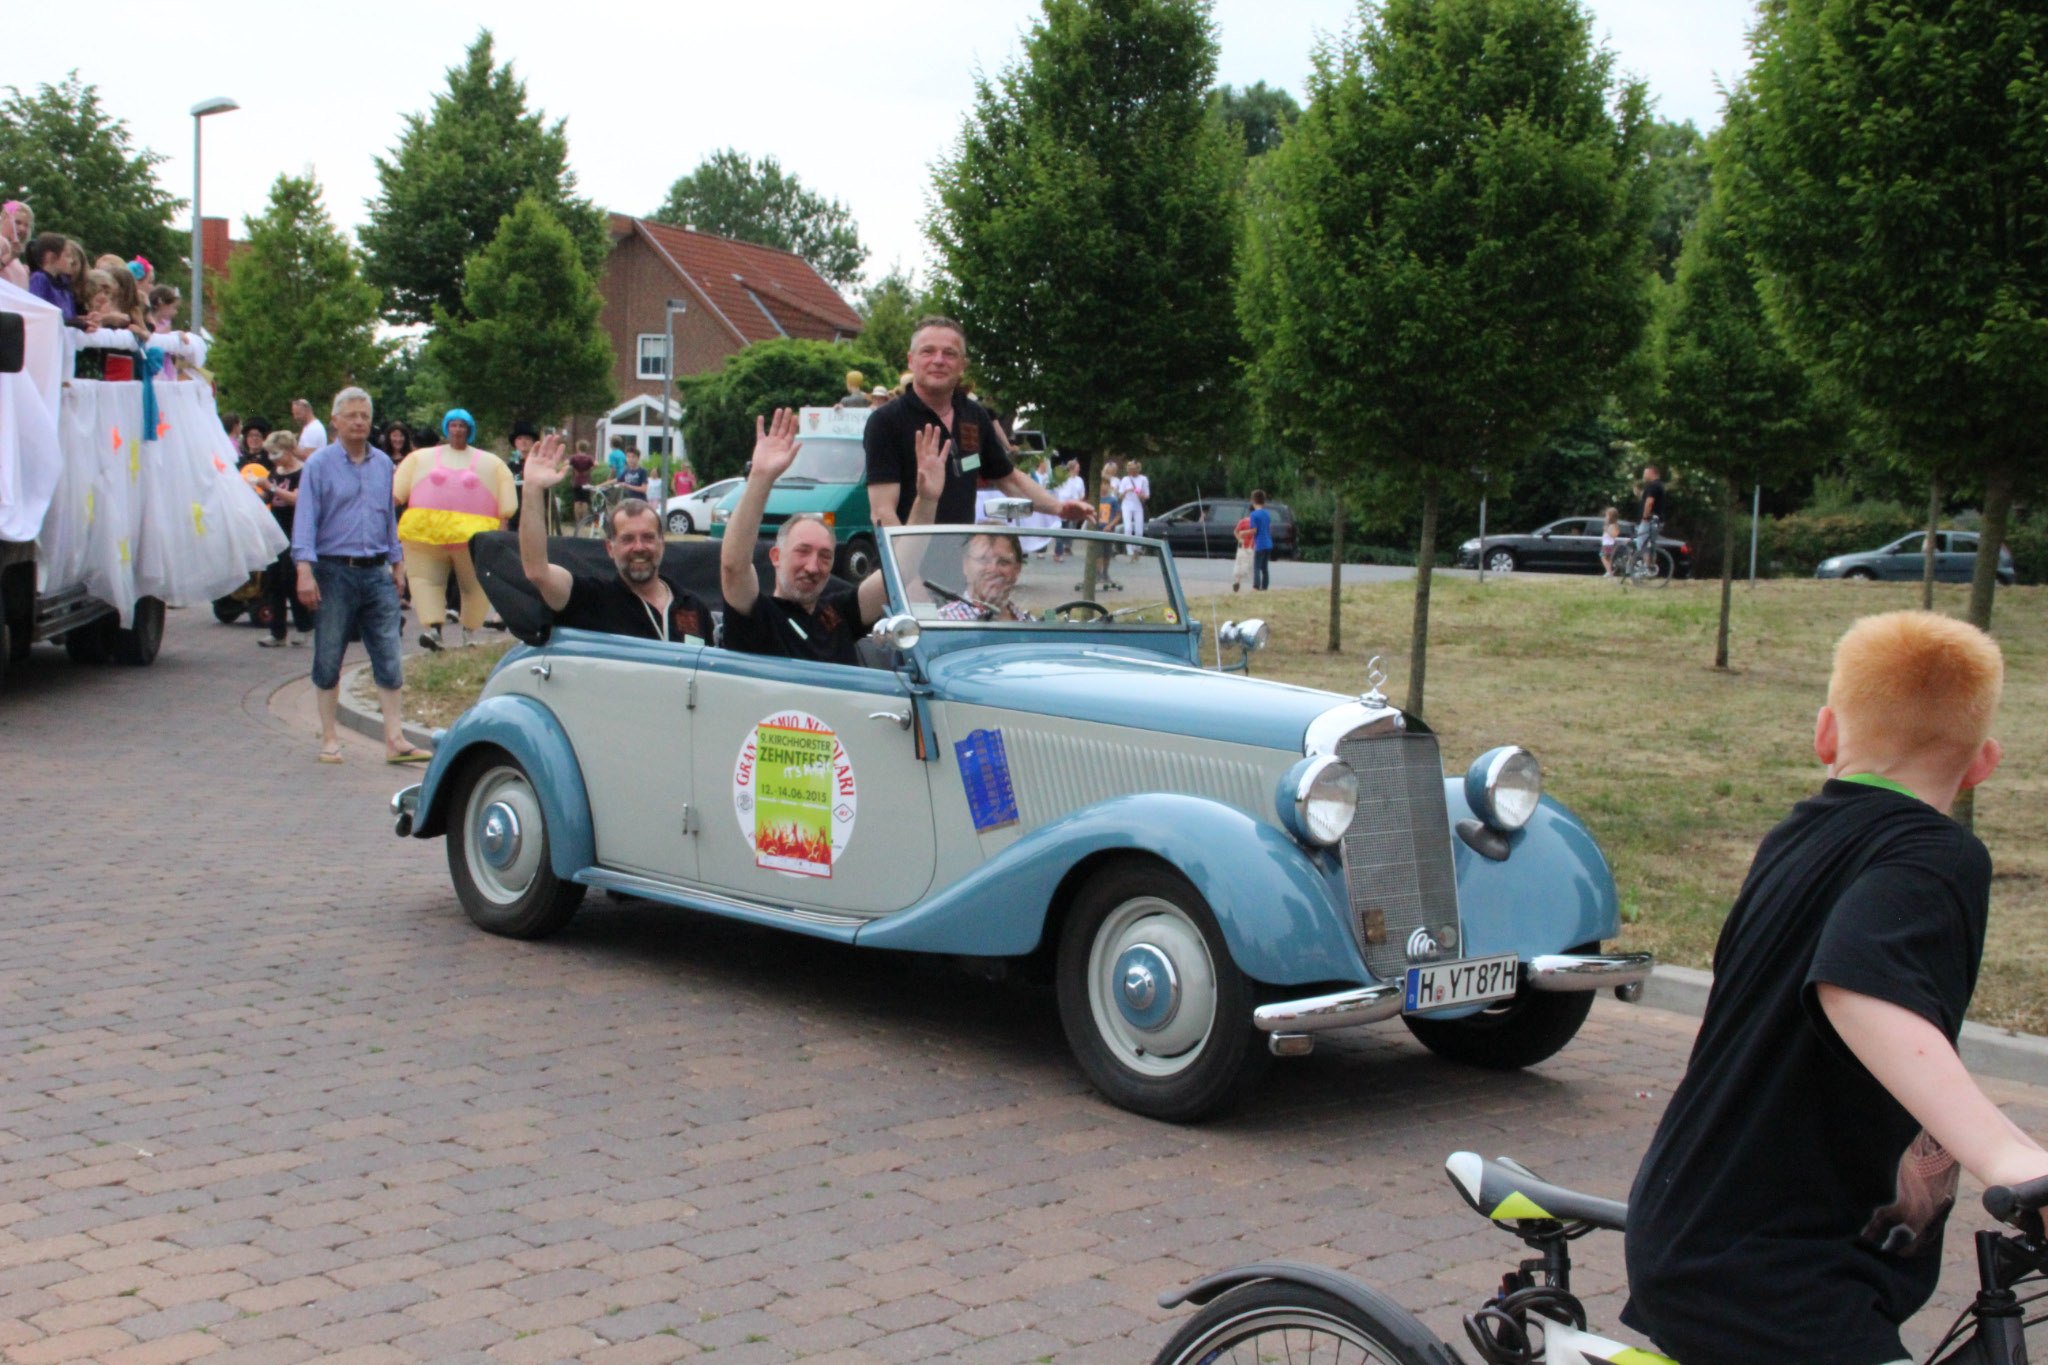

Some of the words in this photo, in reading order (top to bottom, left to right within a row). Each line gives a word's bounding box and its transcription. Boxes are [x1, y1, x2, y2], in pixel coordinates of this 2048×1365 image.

[769, 735, 831, 751] KIRCHHORSTER
[760, 747, 830, 768] ZEHNTFEST
[1420, 973, 1434, 1003] H
[1450, 961, 1516, 998] YT87H
